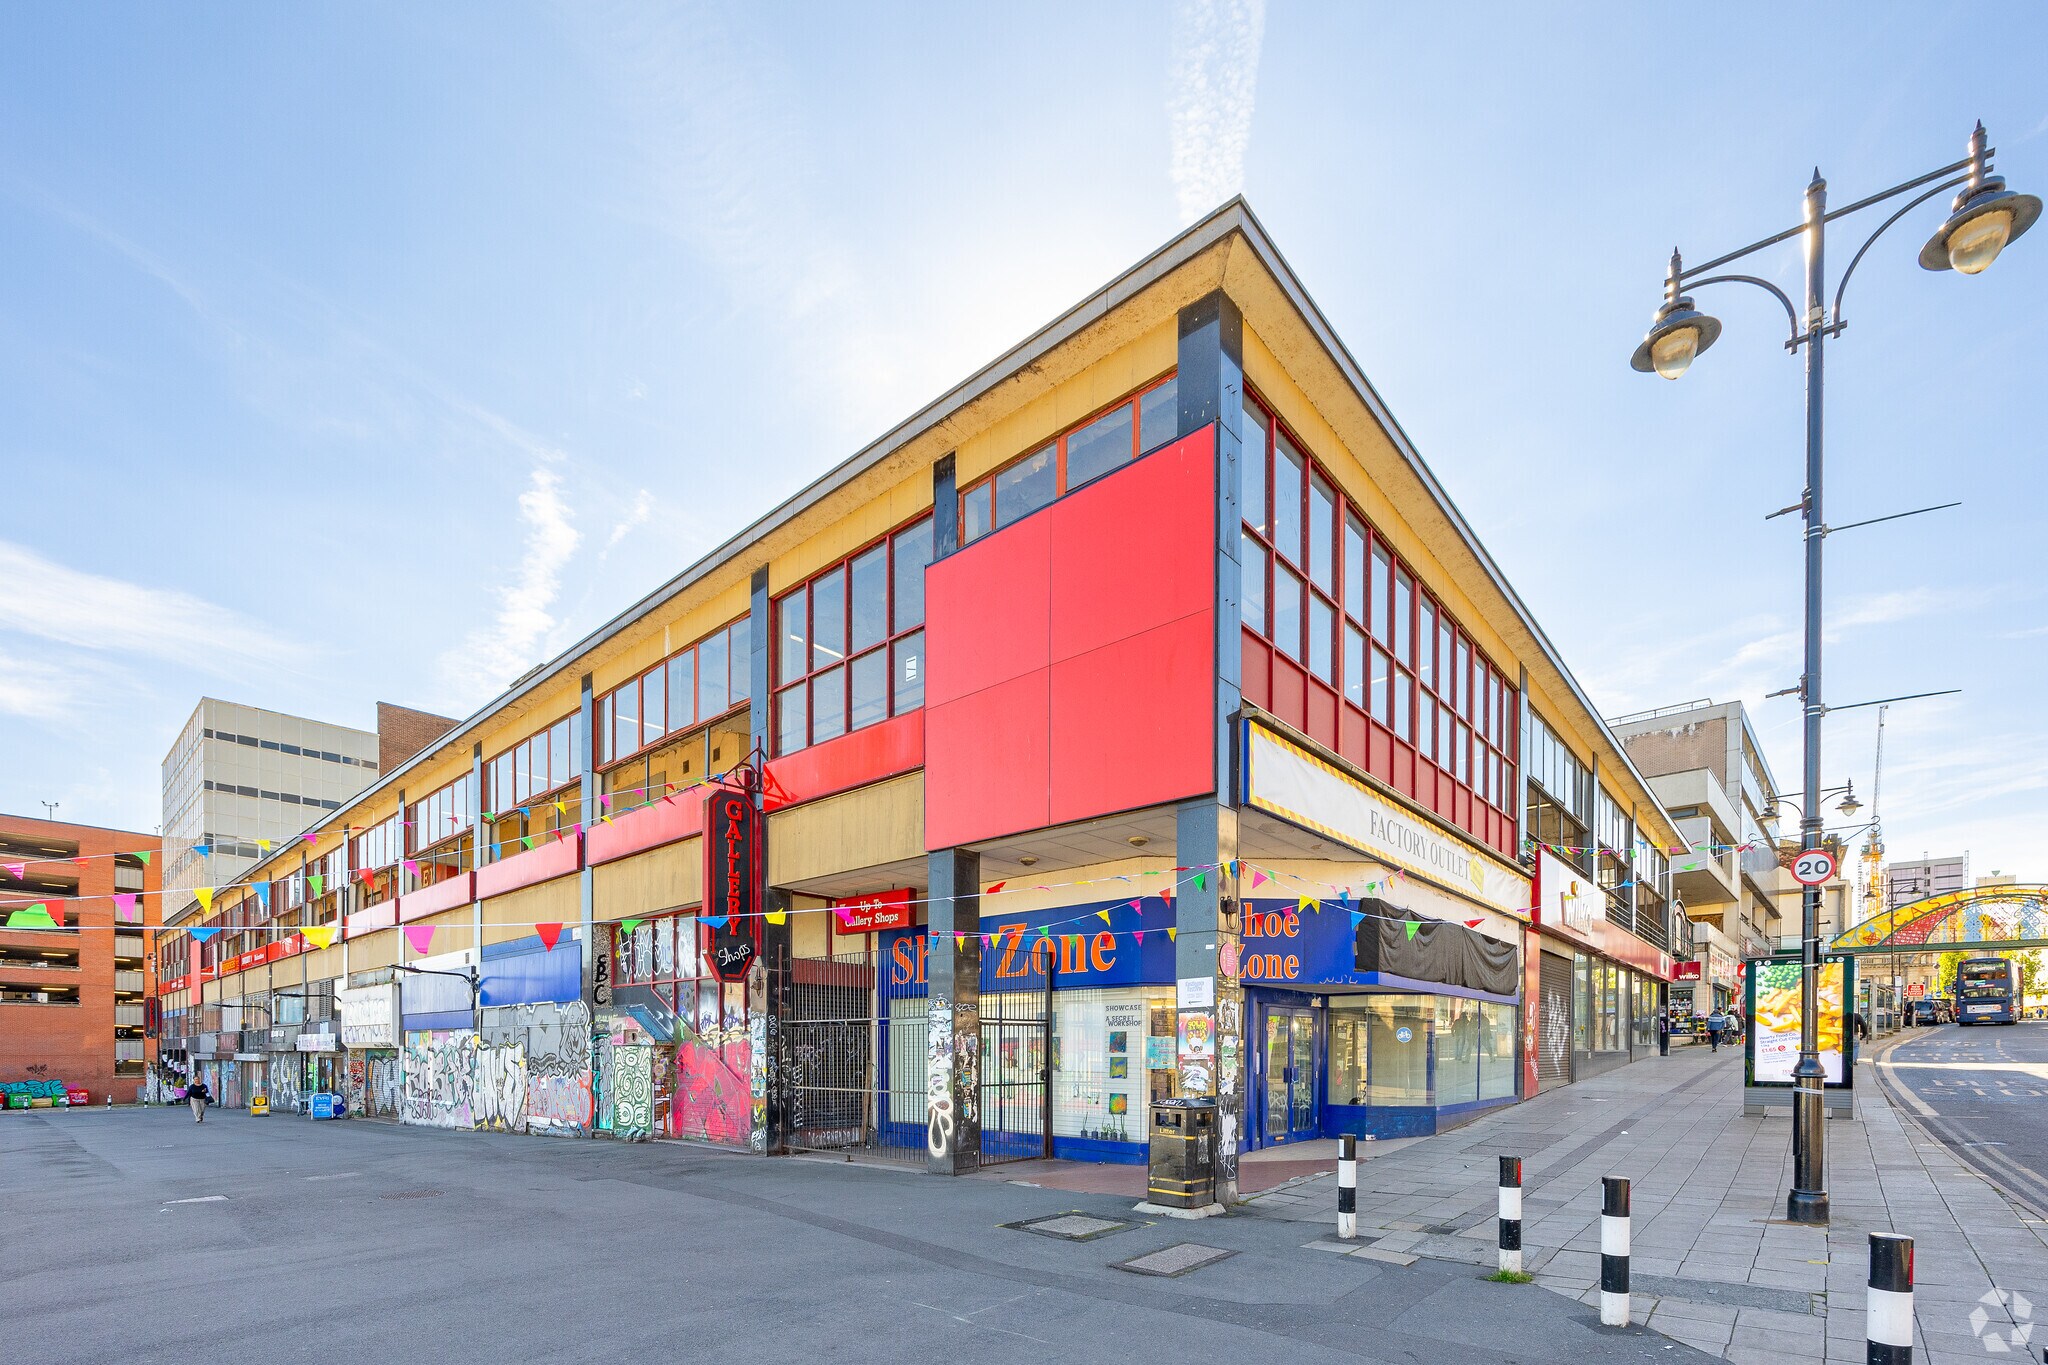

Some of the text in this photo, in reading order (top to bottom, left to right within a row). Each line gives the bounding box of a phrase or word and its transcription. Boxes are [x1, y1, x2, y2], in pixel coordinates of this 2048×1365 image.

[1370, 808, 1428, 860] FACTORY
[1430, 842, 1470, 880] OUTLET
[725, 800, 743, 936] GALLERY
[1798, 860, 1829, 875] 20
[860, 898, 882, 913] Up To
[1560, 881, 1593, 936] wilko
[875, 912, 898, 924] Shops
[1239, 902, 1299, 938] hoe
[718, 943, 751, 966] Shops
[995, 923, 1117, 978] Zone
[1679, 971, 1700, 980] wilko
[1106, 1004, 1141, 1012] SHOWCASE
